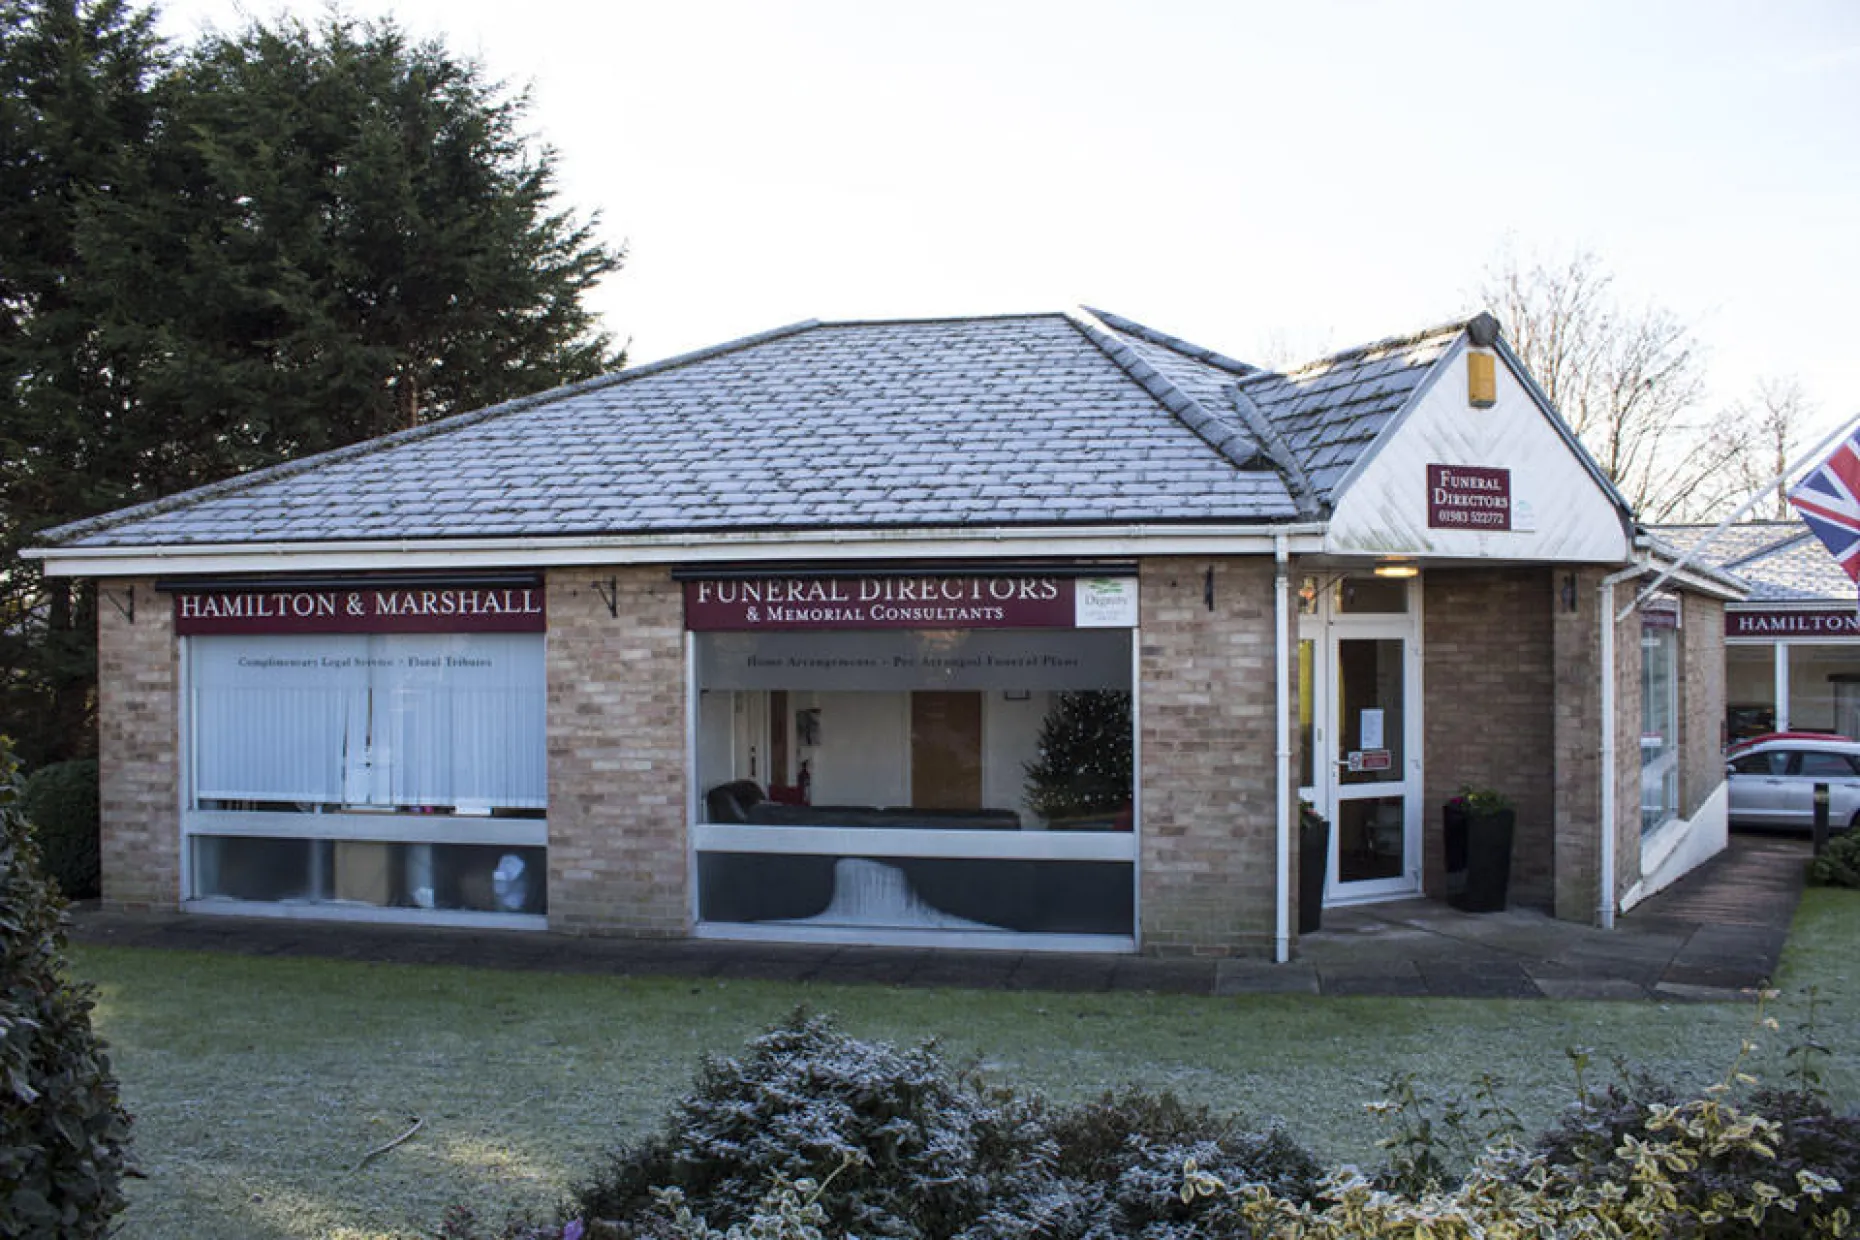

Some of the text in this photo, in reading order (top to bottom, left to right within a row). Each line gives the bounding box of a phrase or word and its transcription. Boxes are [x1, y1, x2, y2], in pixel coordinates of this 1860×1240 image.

[1440, 470, 1502, 490] FUNERAL
[1434, 488, 1508, 508] DIRECTORS
[697, 578, 1058, 603] FUNERAL DIRECTORS
[180, 590, 542, 617] HAMILTON & MARSHALL
[745, 604, 1005, 622] & MEMORIAL CONSULTANTS
[1739, 616, 1859, 631] HAMILTON
